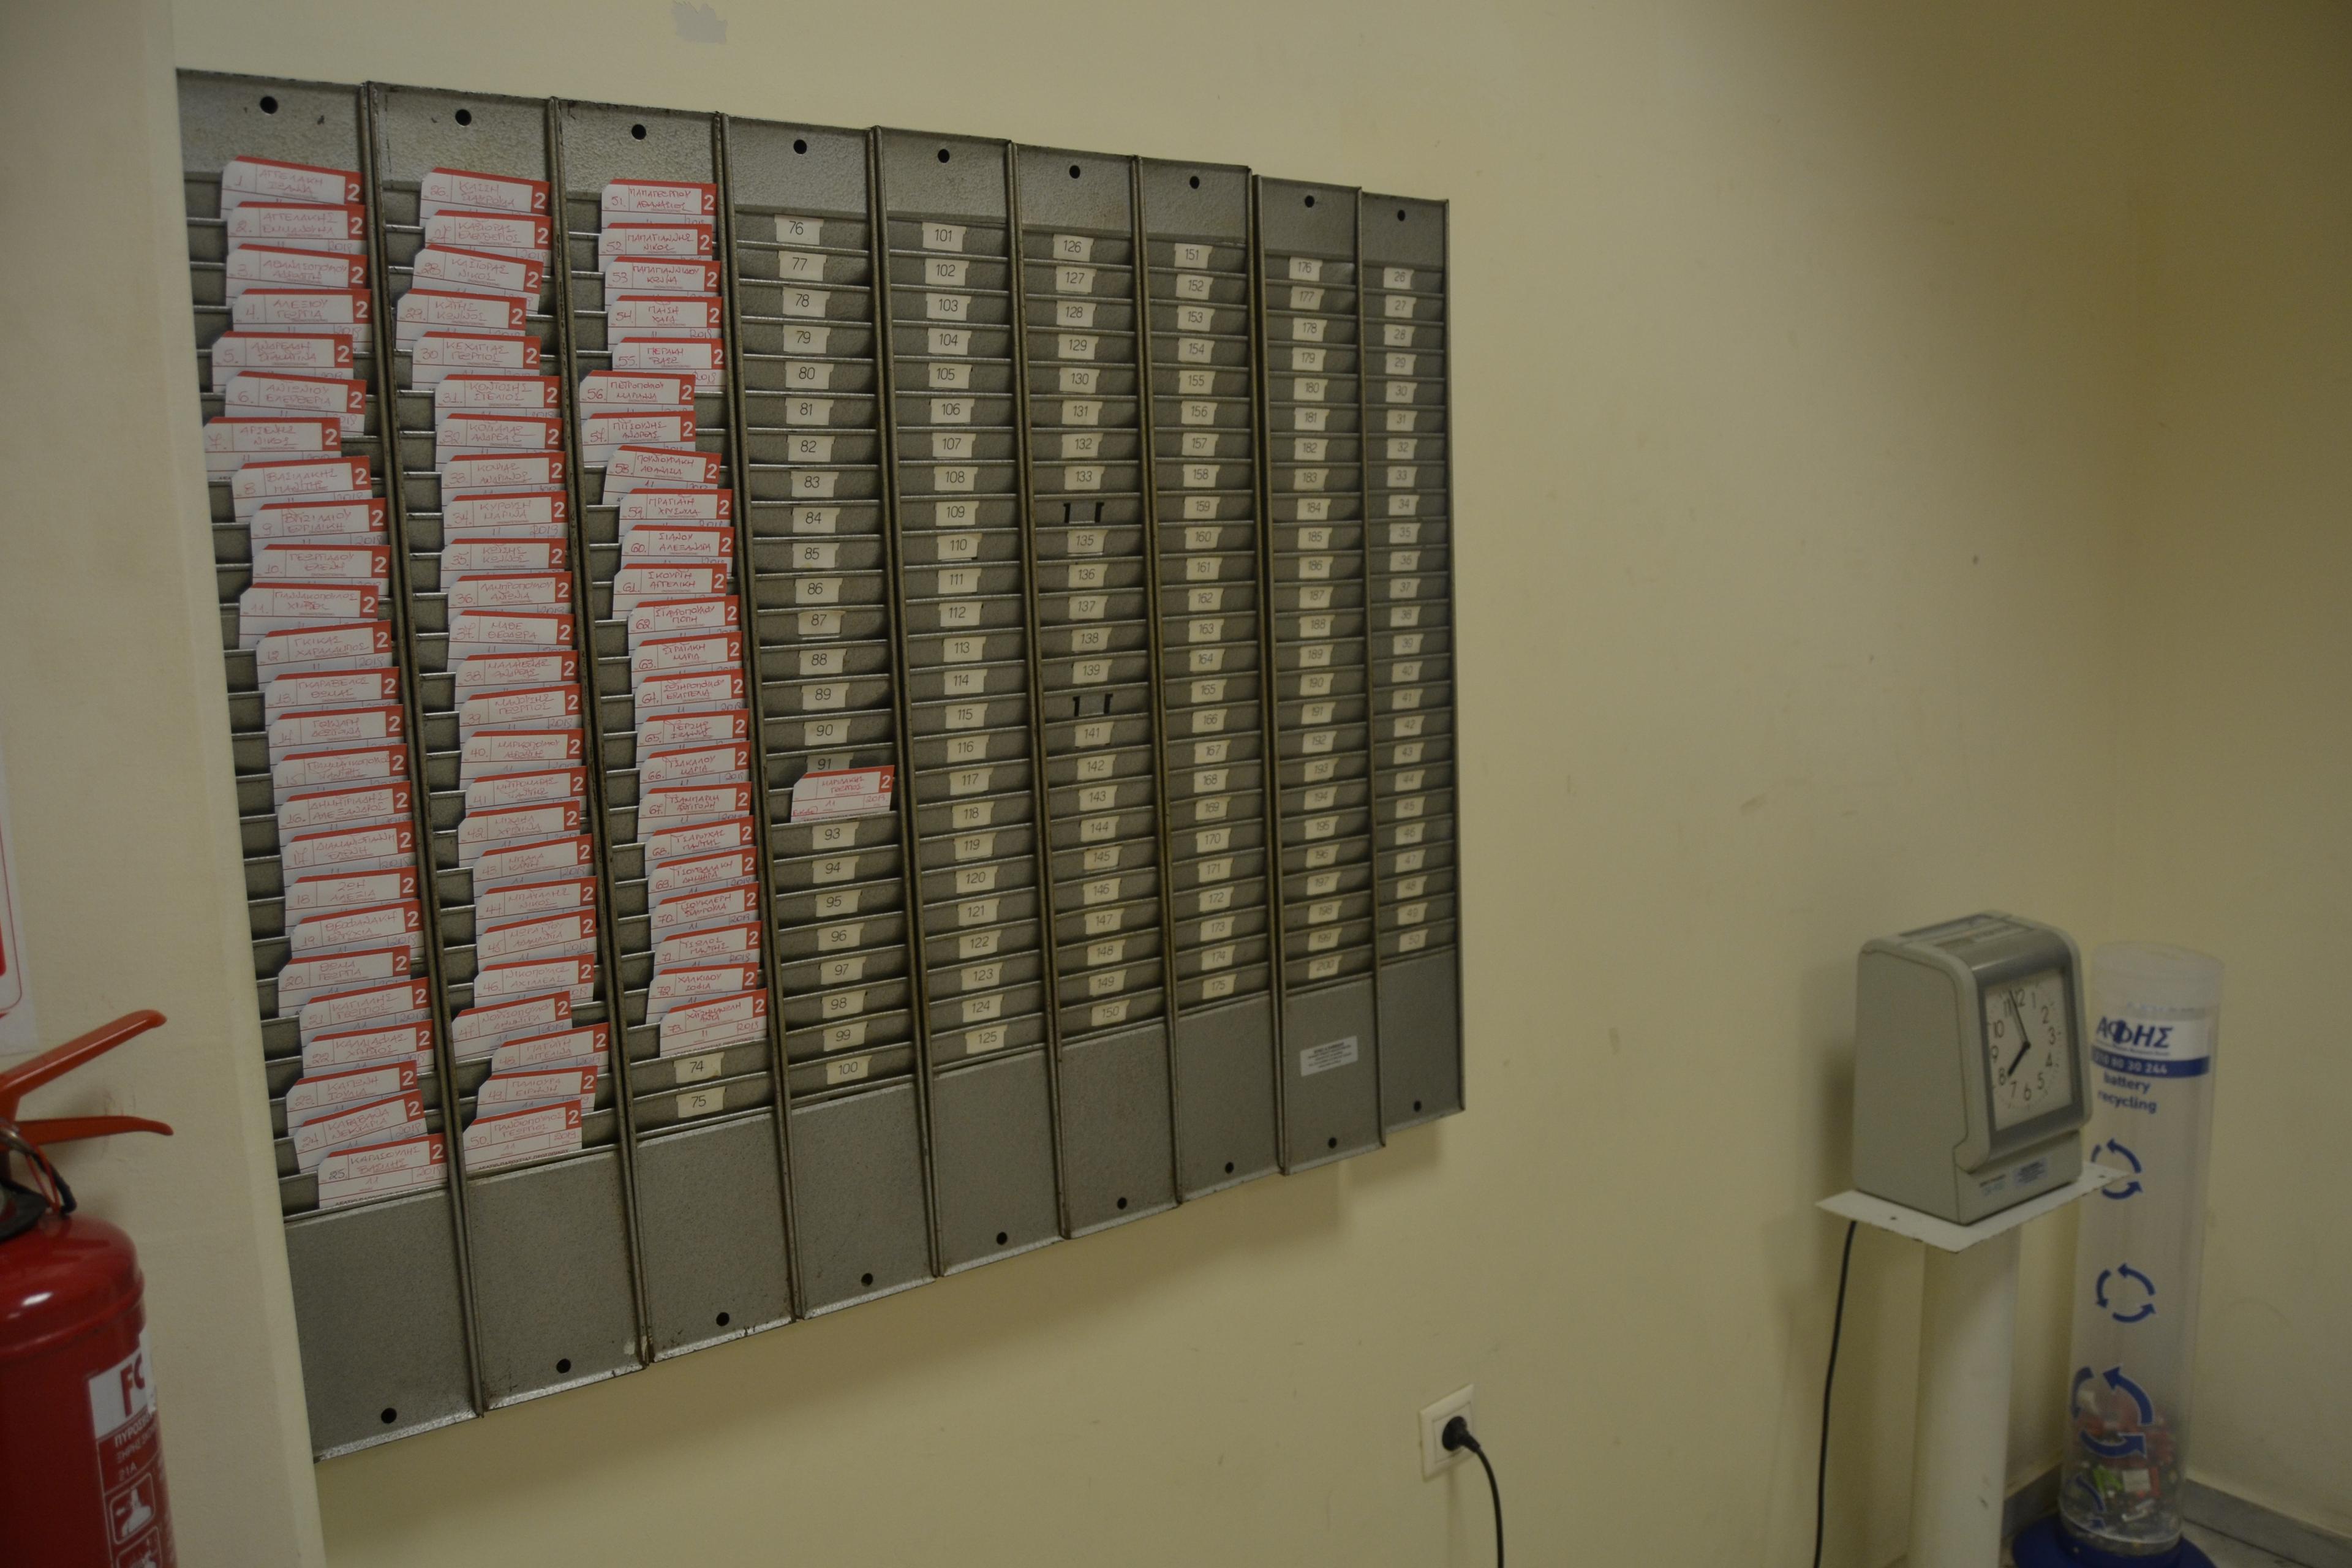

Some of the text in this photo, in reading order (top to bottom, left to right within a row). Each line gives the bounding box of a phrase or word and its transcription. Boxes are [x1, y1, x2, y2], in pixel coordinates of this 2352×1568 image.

[347, 183, 360, 202] 2
[534, 192, 546, 209] 2
[704, 195, 714, 210] 2
[790, 221, 804, 235] 76
[935, 229, 952, 241] 101
[1064, 240, 1082, 253] 126
[1186, 249, 1199, 260] 151
[793, 257, 807, 271] 77
[937, 264, 956, 277] 102
[526, 272, 539, 288] 2
[707, 272, 717, 287] 2
[1066, 272, 1085, 284] 127
[1188, 280, 1204, 292] 152
[796, 294, 809, 307] 78
[939, 299, 958, 312] 103
[1066, 306, 1083, 318] 128
[1188, 311, 1203, 323] 153
[797, 331, 811, 344] 79
[940, 333, 958, 346] 104
[1069, 339, 1087, 351] 129
[1189, 343, 1204, 355] 154
[799, 367, 815, 380] 80
[937, 368, 955, 380] 105
[1071, 373, 1089, 385] 130
[800, 402, 812, 415] 81
[942, 403, 960, 415] 106
[1074, 405, 1088, 417] 131
[1191, 405, 1207, 417] 156
[325, 429, 337, 446] 2
[943, 437, 961, 450] 107
[801, 440, 816, 453] 82
[1076, 438, 1092, 450] 132
[707, 464, 717, 479] 2
[946, 471, 965, 483] 108
[1076, 470, 1092, 482] 133
[1193, 469, 1208, 480] 158
[804, 476, 820, 488] 83
[947, 506, 965, 518] 109
[1196, 501, 1210, 512] 159
[372, 510, 383, 526] 2
[805, 511, 821, 524] 84
[951, 539, 967, 551] 110
[1077, 535, 1094, 546] 135
[805, 547, 819, 560] 85
[951, 573, 963, 585] 111
[1079, 568, 1095, 580] 136
[808, 582, 823, 595] 86
[949, 606, 965, 618] 112
[1079, 601, 1096, 612] 137
[728, 606, 737, 620] 2
[811, 614, 827, 626] 87
[1082, 632, 1098, 644] 138
[955, 642, 970, 654] 113
[812, 654, 827, 666] 88
[1083, 664, 1100, 676] 139
[954, 674, 968, 686] 114
[815, 688, 831, 701] 89
[958, 709, 973, 720] 115
[735, 719, 745, 733] 2
[816, 724, 833, 736] 90
[1085, 728, 1099, 739] 141
[958, 741, 974, 753] 116
[818, 758, 831, 770] 91
[881, 775, 891, 789] 2
[962, 773, 979, 785] 117
[964, 807, 979, 819] 118
[1091, 821, 1108, 833] 144
[825, 828, 840, 840] 93
[965, 839, 980, 851] 119
[826, 862, 840, 874] 94
[967, 872, 986, 884] 120
[402, 877, 414, 893] 2
[1093, 883, 1109, 895] 146
[826, 895, 842, 908] 95
[968, 905, 984, 917] 121
[831, 930, 846, 942] 96
[970, 936, 989, 948] 122
[835, 963, 849, 975] 97
[974, 968, 993, 981] 123
[1098, 976, 1115, 988] 149
[831, 997, 846, 1010] 98
[972, 1000, 990, 1013] 124
[1102, 1006, 1119, 1017] 150
[836, 1029, 851, 1041] 99
[979, 1031, 997, 1044] 125
[2096, 1016, 2173, 1049] ΑΦΗΣ
[690, 1061, 704, 1073] 74
[839, 1061, 858, 1075] 100
[583, 1075, 594, 1090] 2
[2103, 1072, 2151, 1095] battery
[692, 1095, 706, 1107] 75
[432, 1144, 443, 1159] 2
